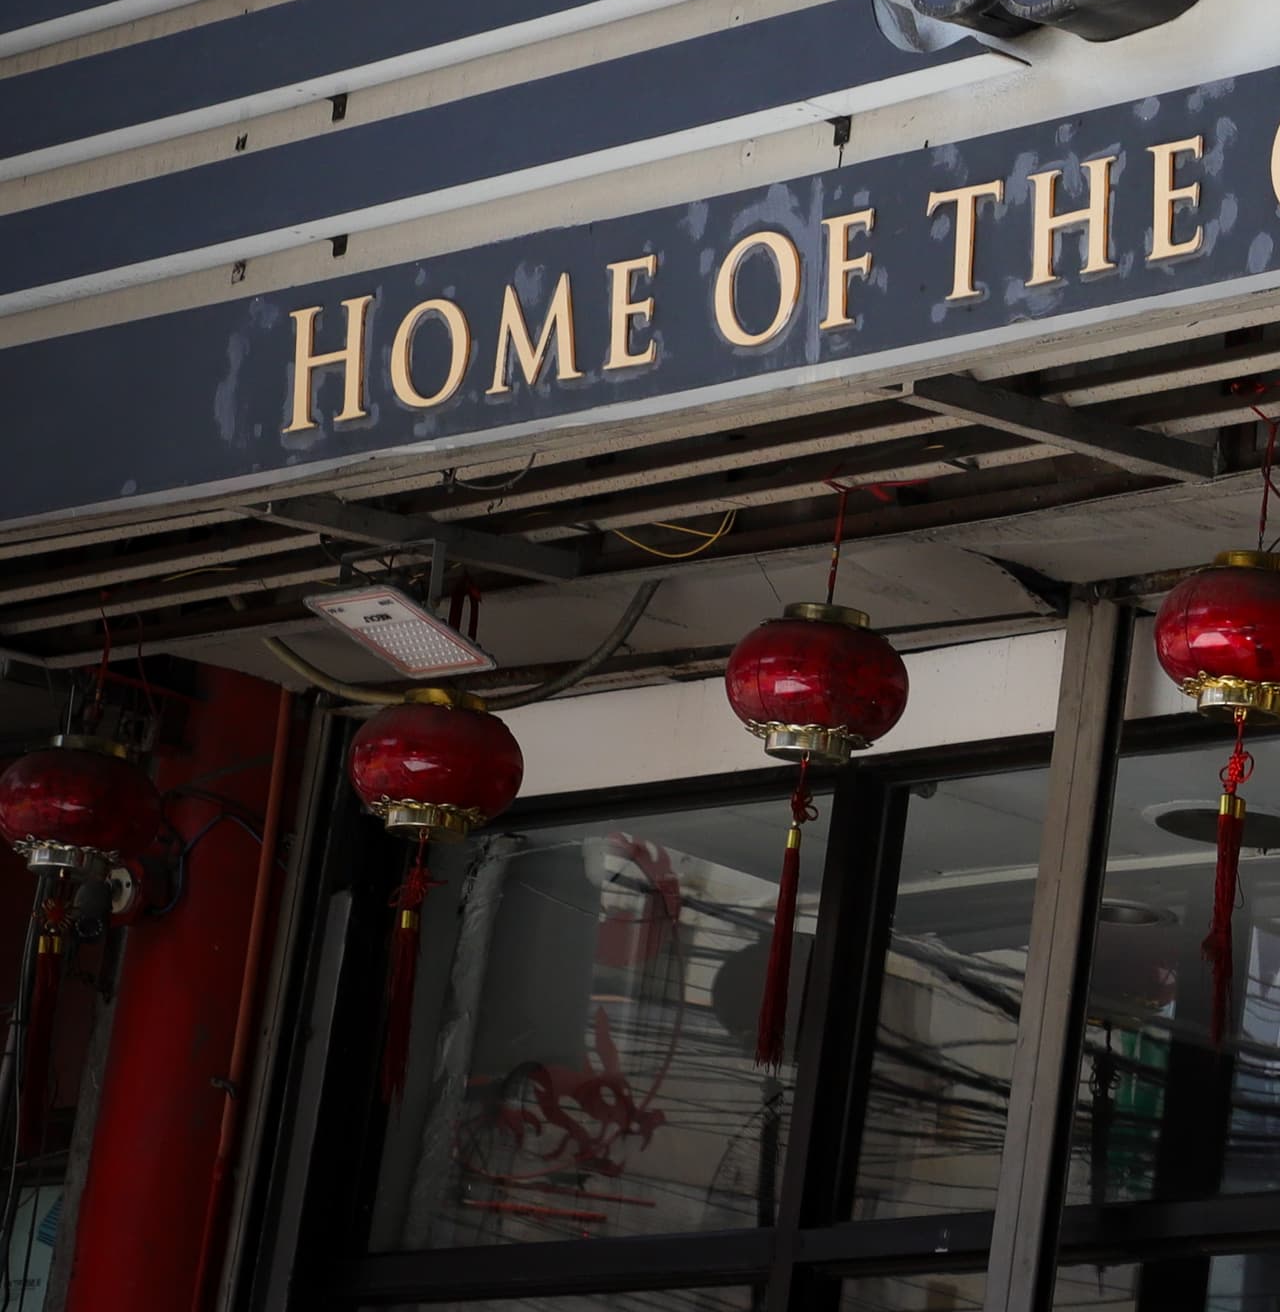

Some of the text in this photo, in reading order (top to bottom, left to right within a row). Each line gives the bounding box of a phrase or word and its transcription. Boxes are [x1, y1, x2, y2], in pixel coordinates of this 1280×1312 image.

[282, 253, 658, 435] HOME
[713, 207, 875, 349] OF
[926, 134, 1204, 304] THE
